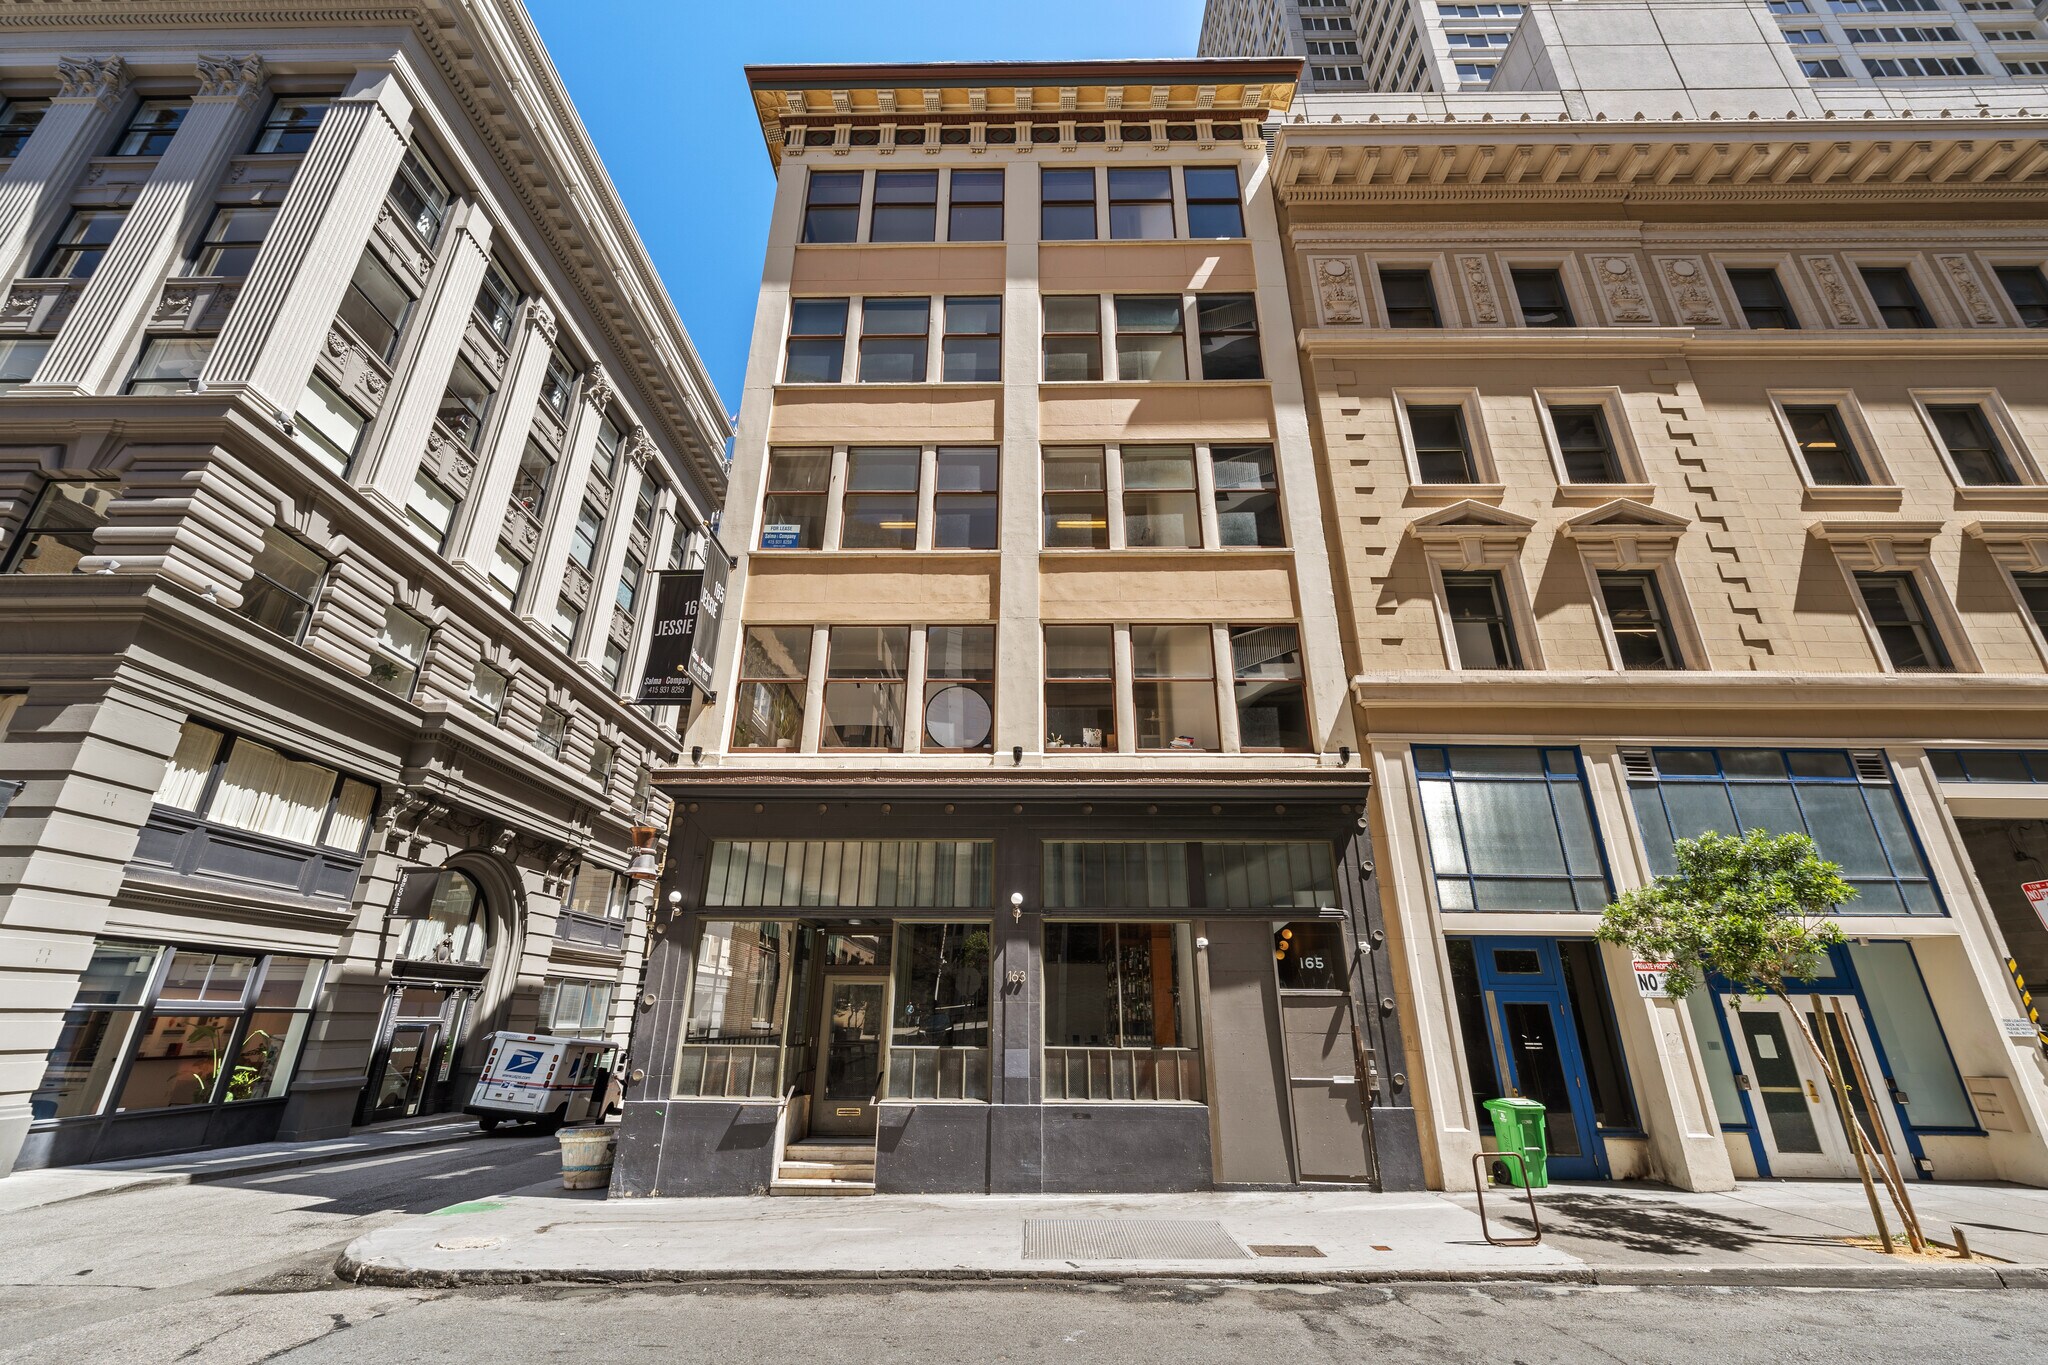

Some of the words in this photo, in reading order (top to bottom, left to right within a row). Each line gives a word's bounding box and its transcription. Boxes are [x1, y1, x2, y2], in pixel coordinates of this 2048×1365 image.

[684, 600, 699, 616] 16
[701, 587, 718, 619] JESSIE
[655, 619, 694, 637] JESSIE
[644, 677, 662, 686] Salma
[2026, 889, 2042, 900] NO
[1299, 956, 1324, 969] 165
[1634, 962, 1654, 970] PRIVATE
[1008, 970, 1026, 983] 163
[1637, 973, 1658, 991] NO
